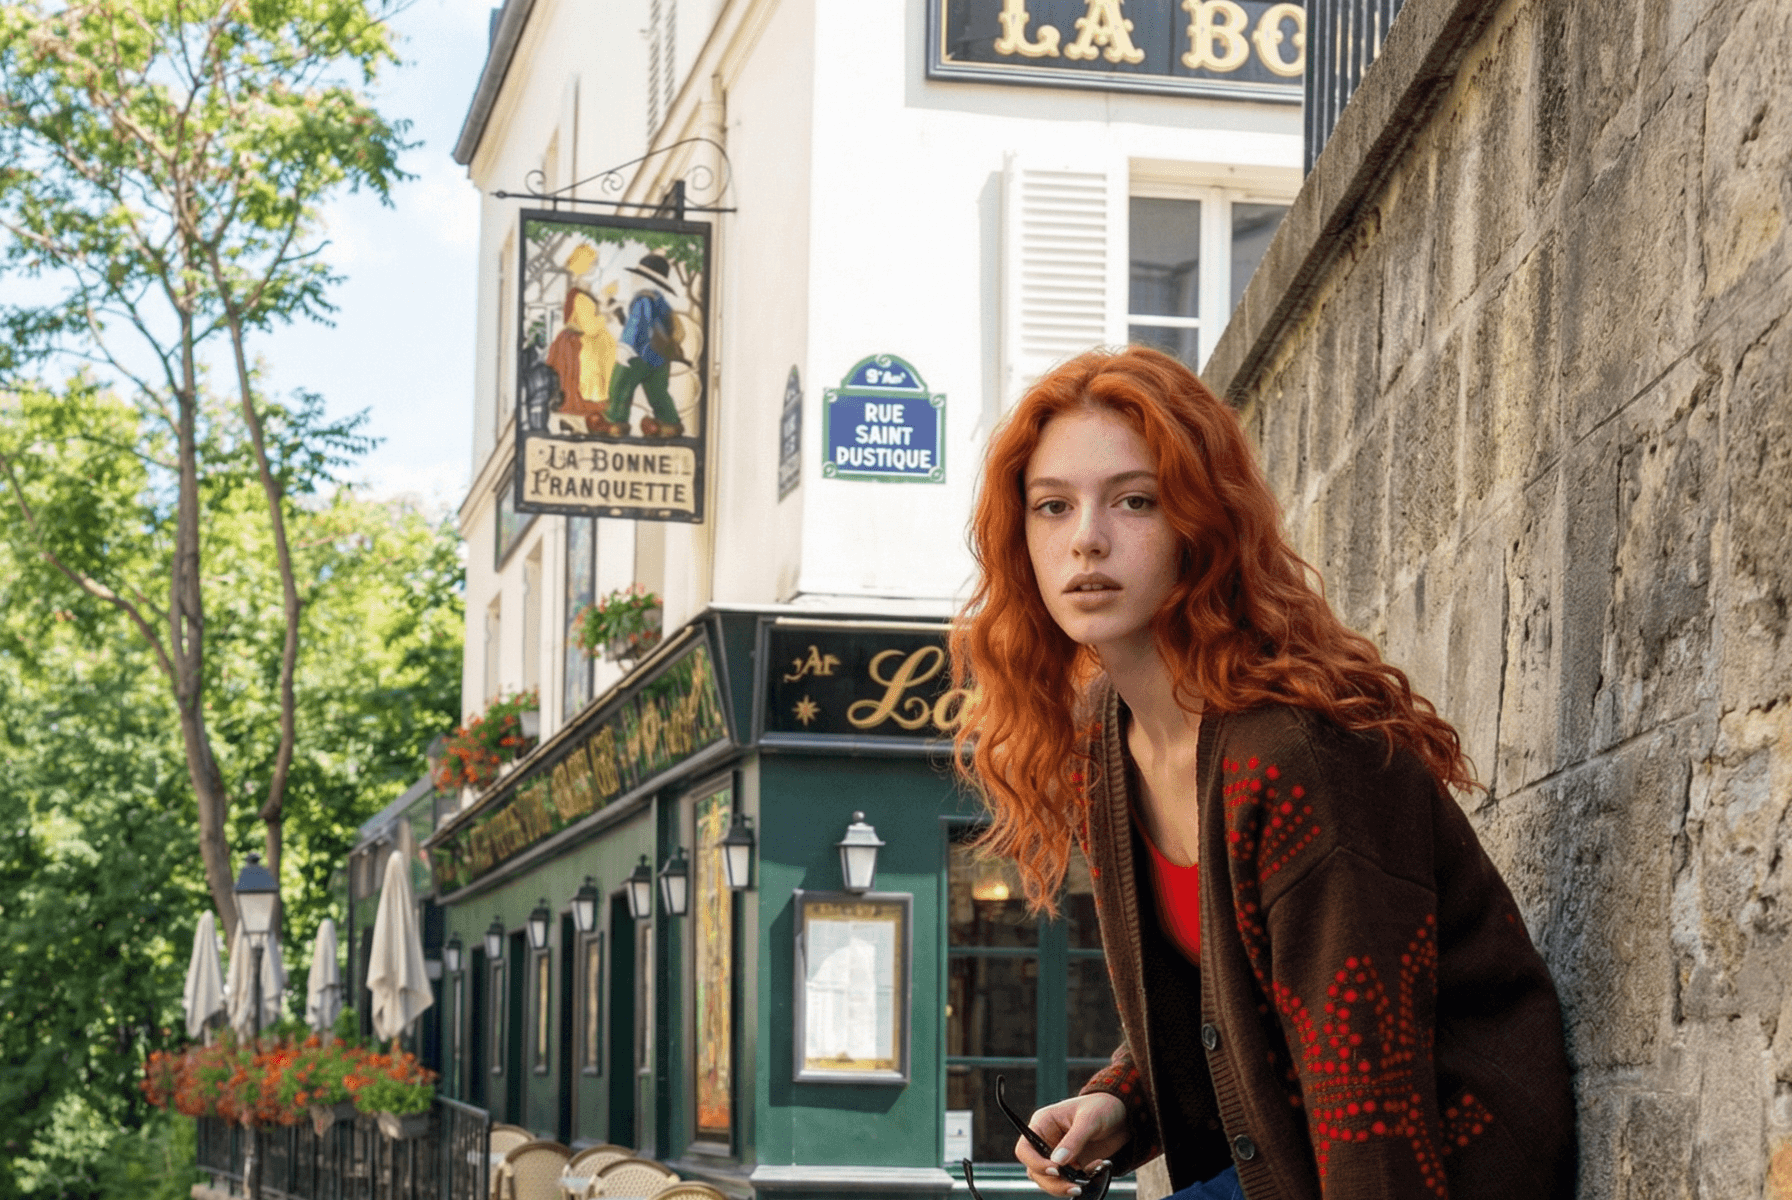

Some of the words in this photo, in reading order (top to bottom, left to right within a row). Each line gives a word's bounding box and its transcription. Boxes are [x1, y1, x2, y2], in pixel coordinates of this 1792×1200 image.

[994, 0, 1145, 64] LA
[1181, 0, 1304, 77] BO
[864, 402, 905, 424] RUE
[855, 424, 914, 446] SAINT
[545, 445, 579, 471] LA
[590, 447, 673, 475] BONNE
